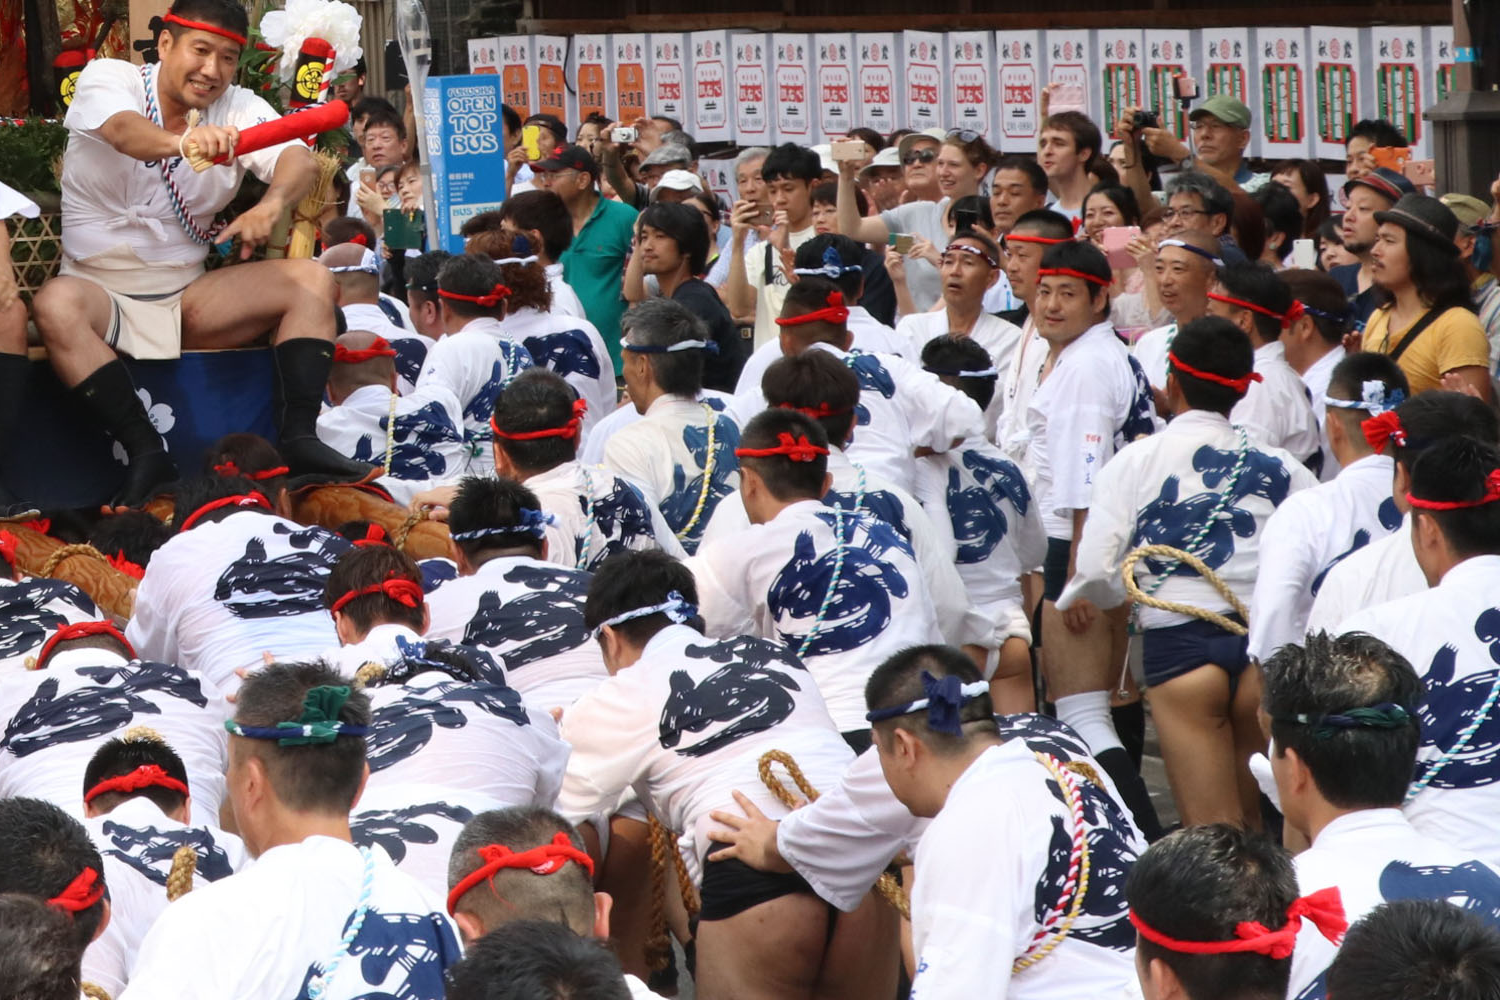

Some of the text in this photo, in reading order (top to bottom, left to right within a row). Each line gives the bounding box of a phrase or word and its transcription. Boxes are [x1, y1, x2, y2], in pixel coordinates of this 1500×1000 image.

[448, 96, 496, 112] OPEN
[449, 113, 497, 133] TOP
[451, 133, 498, 154] BUS
